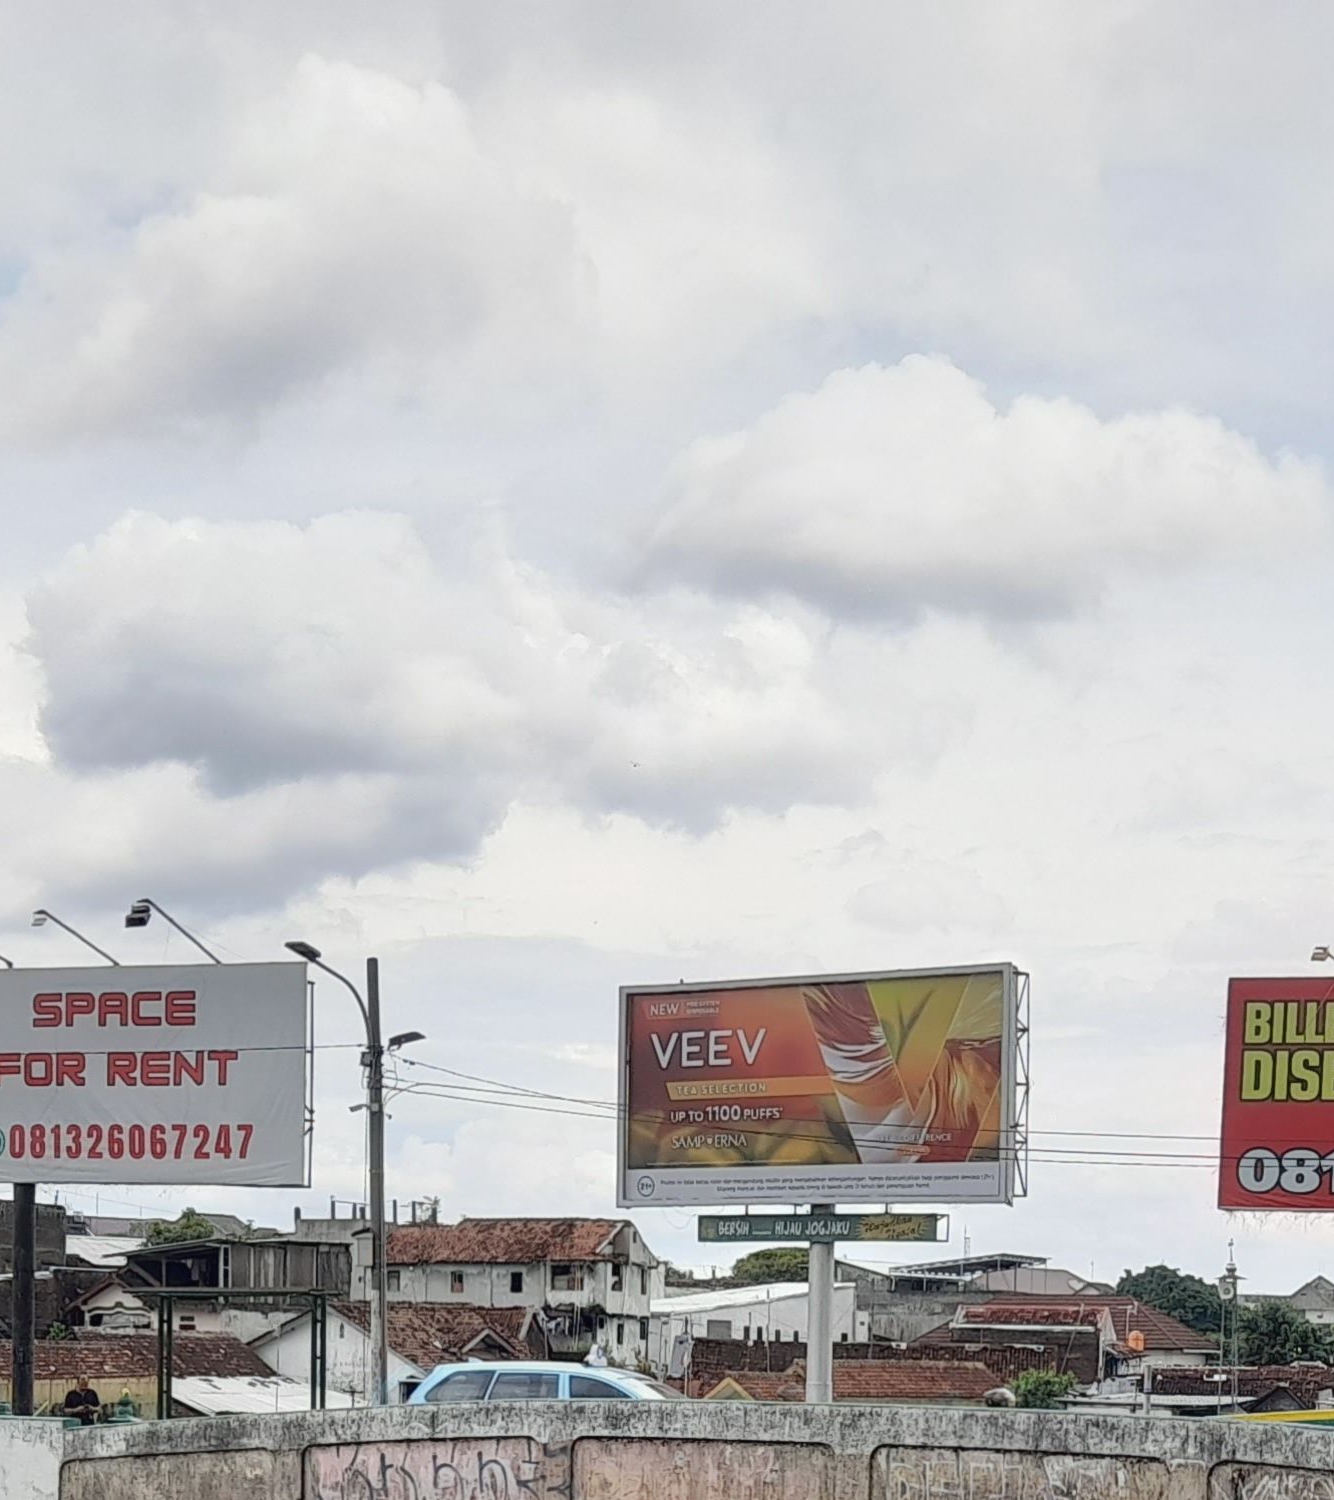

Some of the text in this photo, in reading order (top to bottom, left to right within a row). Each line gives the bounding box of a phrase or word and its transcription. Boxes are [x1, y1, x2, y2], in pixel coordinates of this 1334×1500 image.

[33, 990, 196, 1027] SPACE
[650, 1003, 679, 1016] NEW
[650, 1028, 766, 1069] VEEV
[107, 1050, 238, 1086] RENT
[677, 1083, 767, 1096] TEA SELECTION
[670, 1112, 685, 1123] UP
[688, 1112, 704, 1122] TO
[705, 1105, 741, 1121] 1100
[9, 1124, 254, 1160] 081326067247
[640, 1183, 652, 1191] 21+
[718, 1220, 749, 1236] BERSIH
[775, 1221, 802, 1236] HIJAU
[805, 1220, 850, 1236] JOGJAKU
